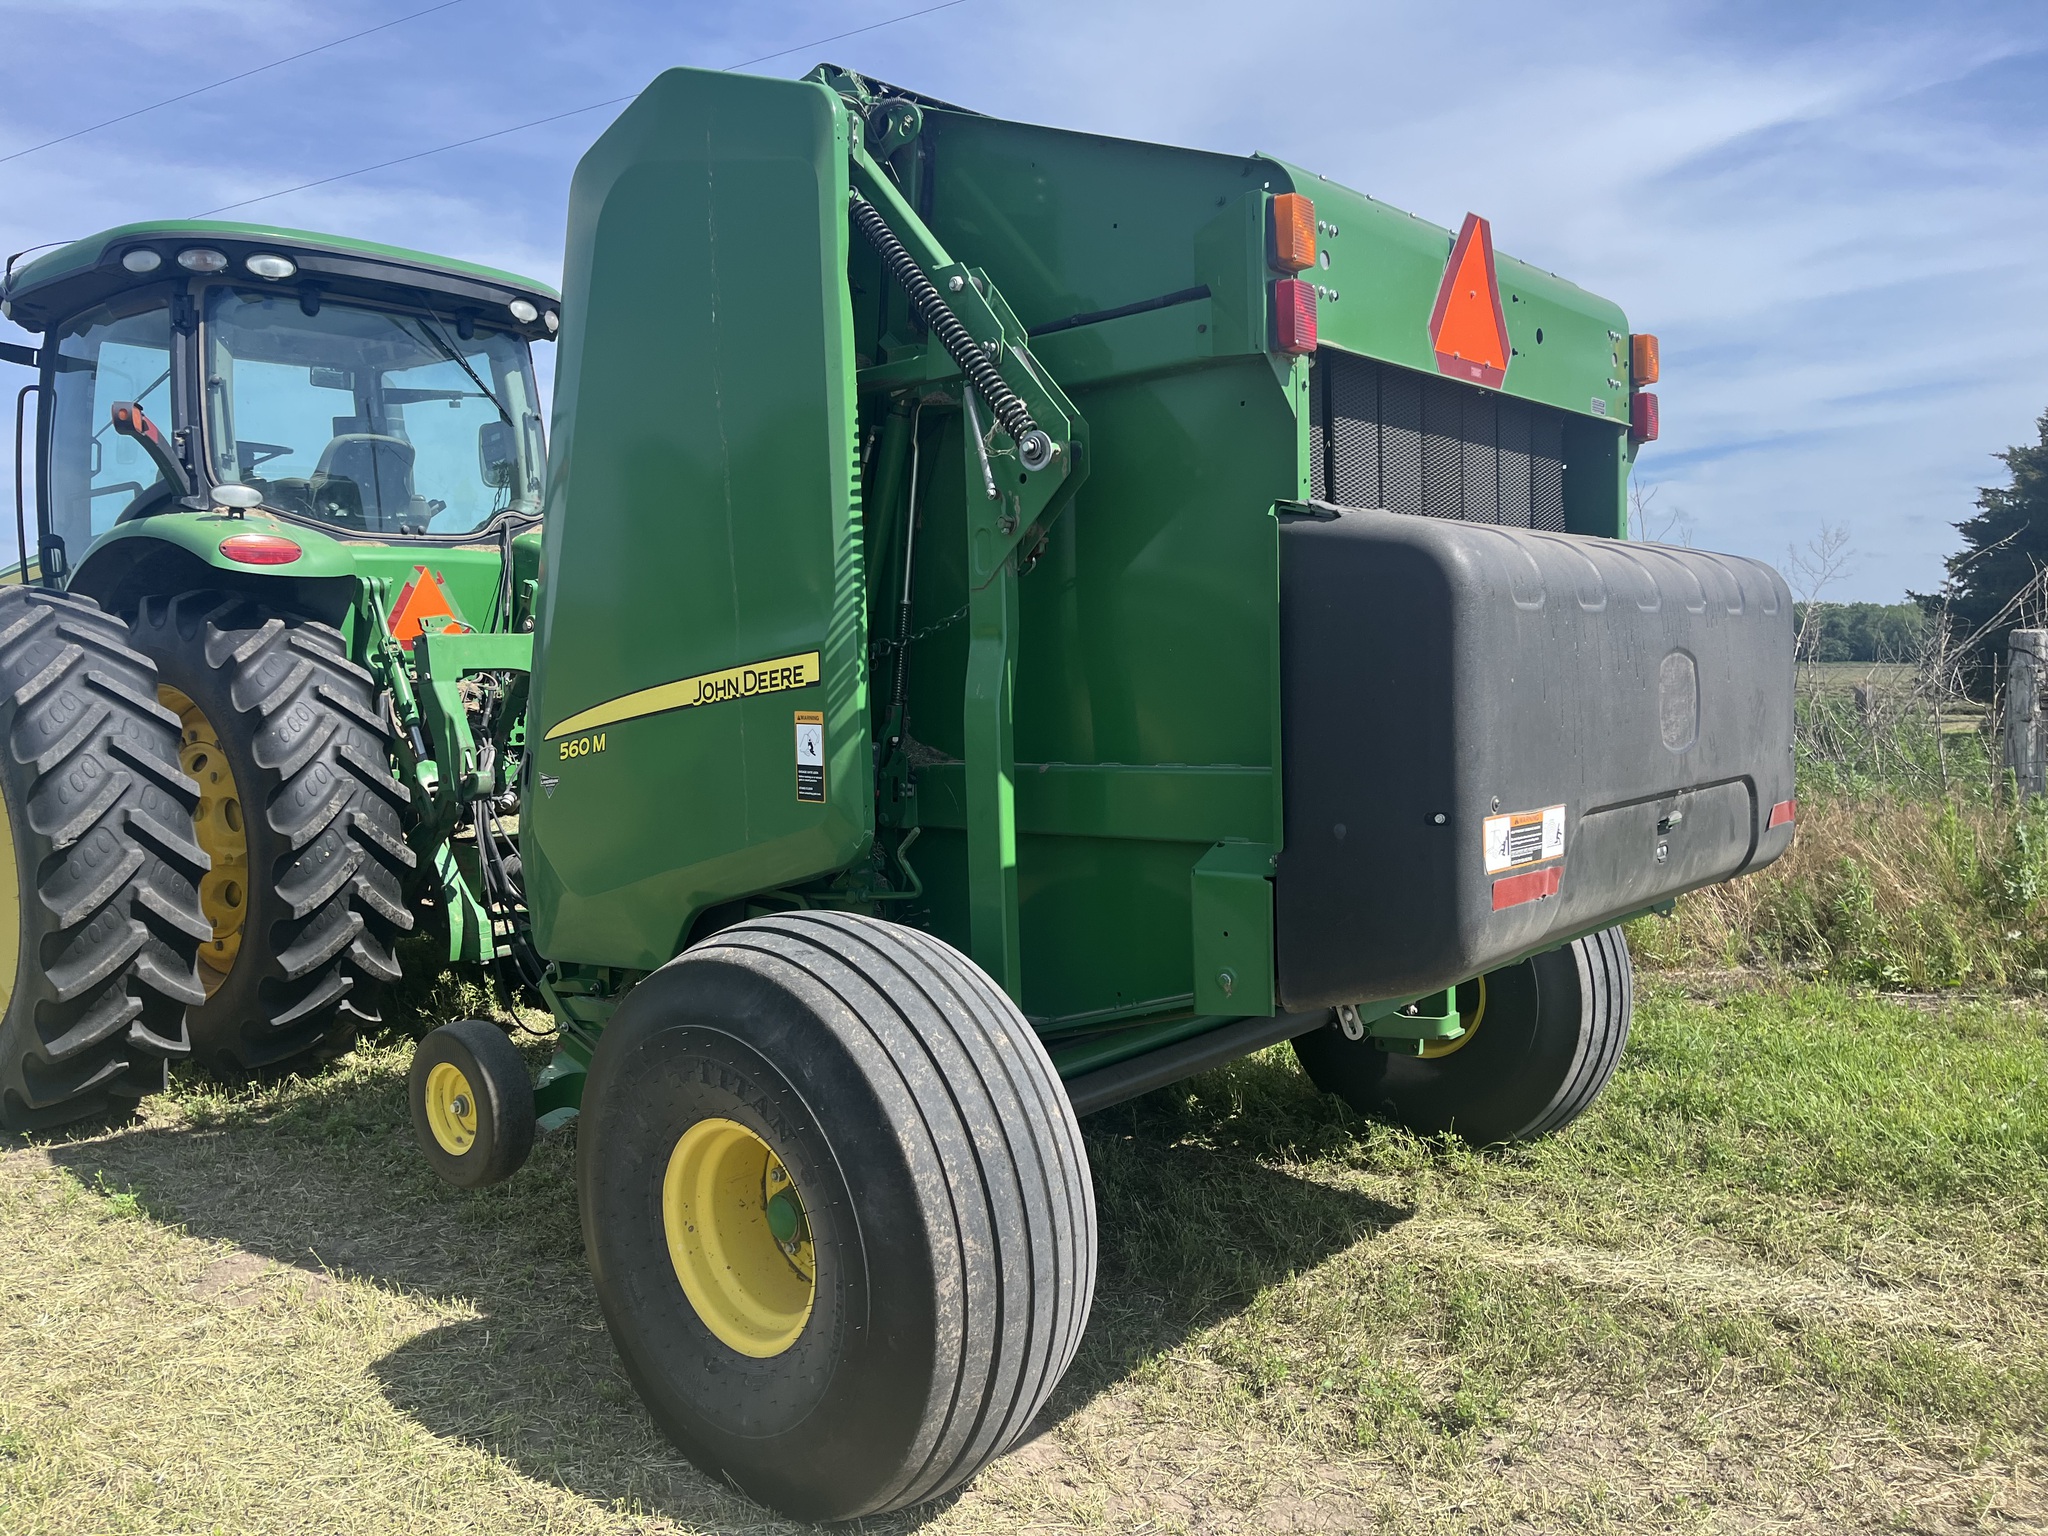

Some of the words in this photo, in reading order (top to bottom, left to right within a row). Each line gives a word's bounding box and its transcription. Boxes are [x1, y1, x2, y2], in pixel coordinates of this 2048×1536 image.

[693, 677, 739, 703] JOHN
[743, 665, 804, 693] DEERE
[560, 737, 590, 760] 560
[592, 733, 606, 753] M
